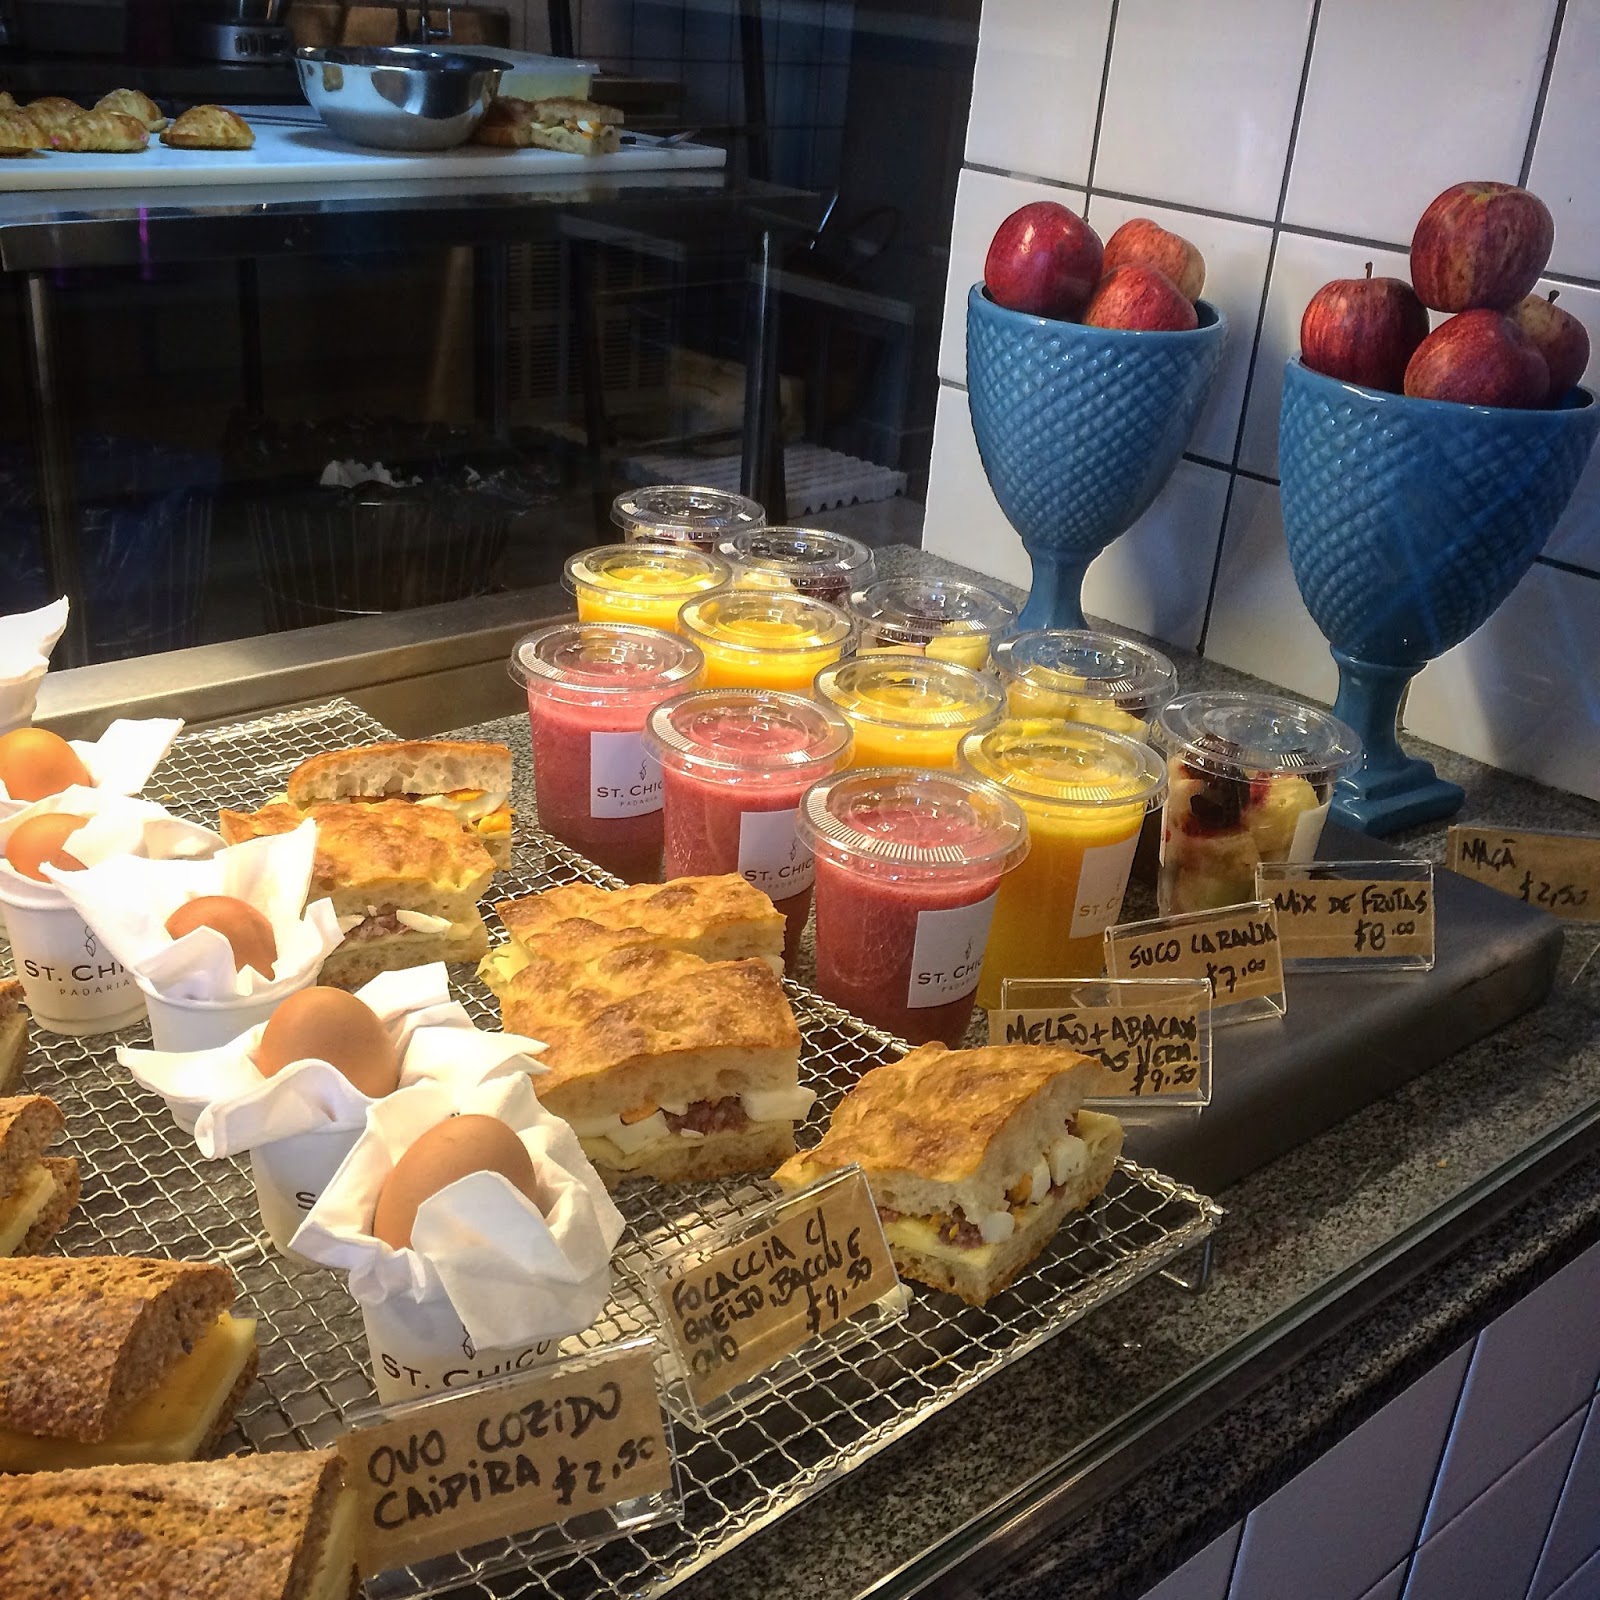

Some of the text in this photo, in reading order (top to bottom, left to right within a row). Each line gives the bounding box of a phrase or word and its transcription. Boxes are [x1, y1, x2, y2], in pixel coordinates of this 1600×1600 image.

[596, 781, 663, 798] ST. CHIC
[744, 858, 815, 881] ST. CHIC
[1328, 893, 1357, 914] DE
[1362, 884, 1429, 914] FRUTAS
[1129, 939, 1181, 969] SUCO
[23, 959, 124, 981] ST. CHI
[917, 972, 947, 985] ST.
[60, 979, 130, 996] PADARIA
[692, 1335, 740, 1376] OVO
[381, 1353, 430, 1389] ST.
[368, 1430, 447, 1487] OVO
